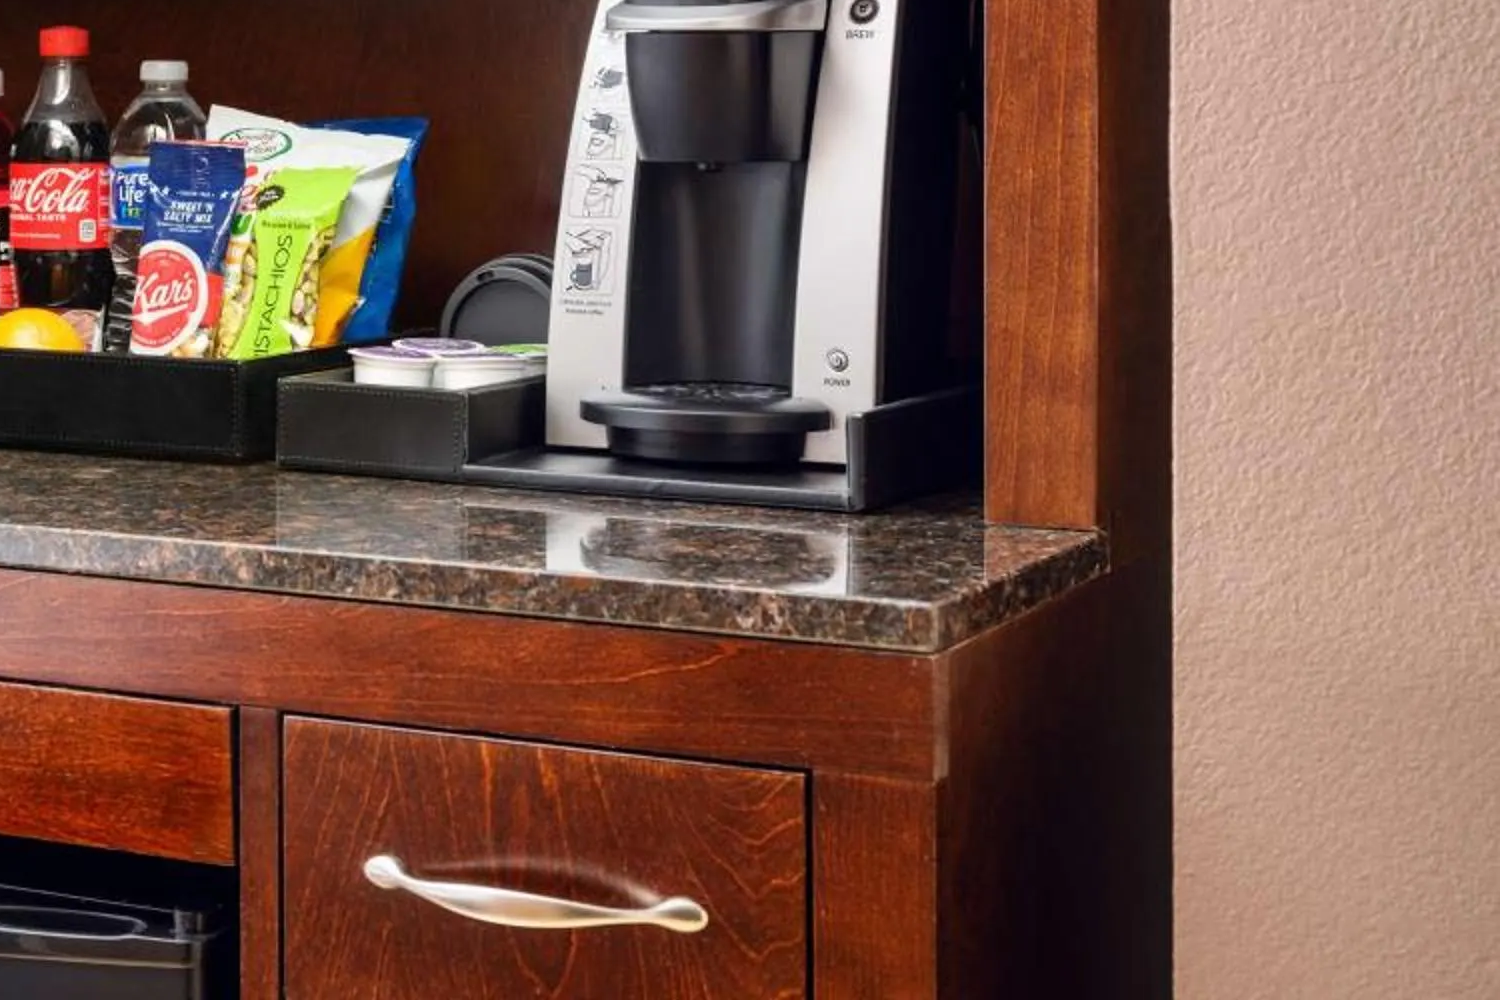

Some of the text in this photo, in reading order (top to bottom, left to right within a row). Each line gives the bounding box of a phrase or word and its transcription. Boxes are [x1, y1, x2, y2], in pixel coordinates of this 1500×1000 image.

[118, 170, 149, 187] Pure
[119, 185, 147, 207] Life
[171, 200, 202, 213] SWEET
[163, 211, 195, 223] SALTY
[133, 271, 195, 311] Kar's
[254, 234, 293, 356] ISTACHIOS
